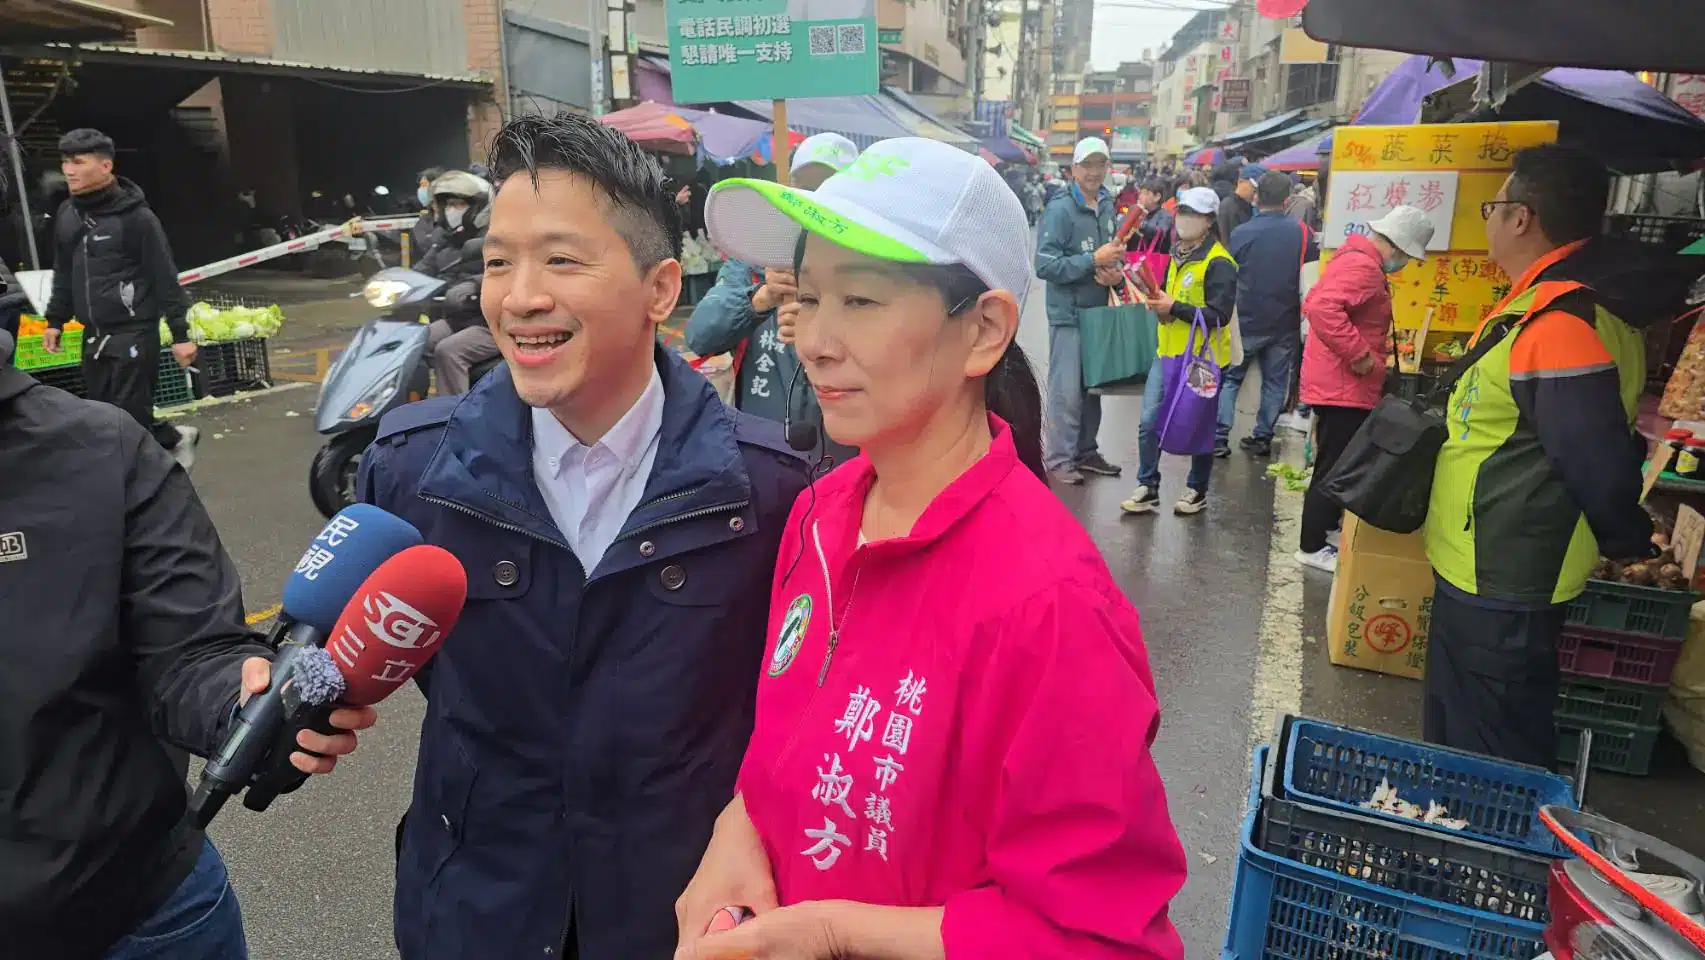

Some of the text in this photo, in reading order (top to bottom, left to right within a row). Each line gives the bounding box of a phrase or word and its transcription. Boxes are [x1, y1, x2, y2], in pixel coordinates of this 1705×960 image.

[679, 15, 792, 38] 電話民調初選
[680, 41, 793, 66] 懇請唯一支持
[294, 514, 360, 581] 民視
[800, 684, 882, 872] 鄭淑方
[863, 668, 928, 863] 桃園市議員
